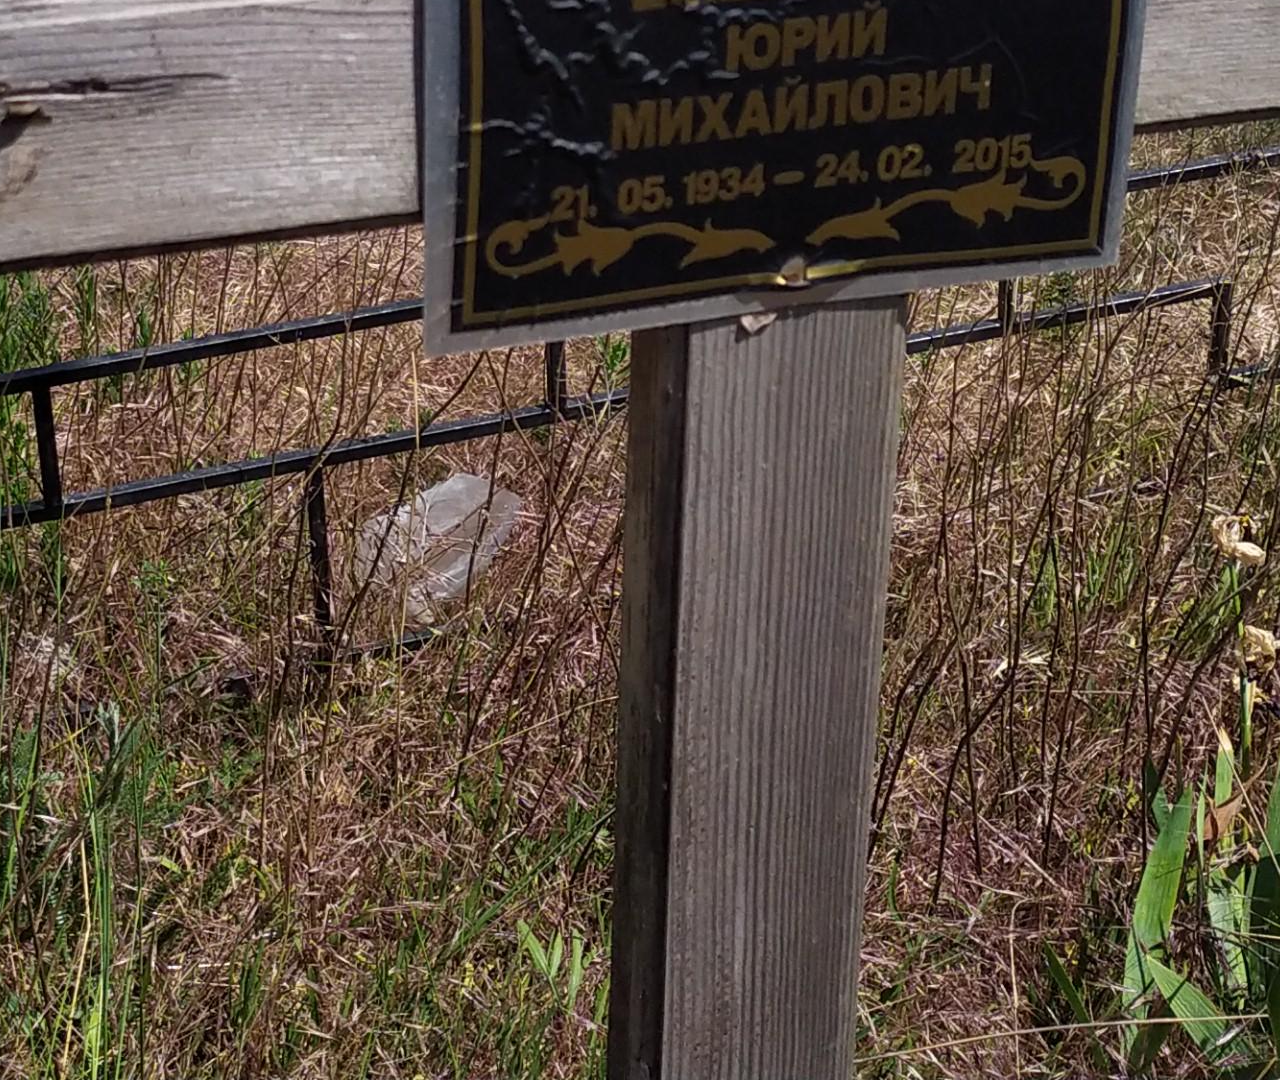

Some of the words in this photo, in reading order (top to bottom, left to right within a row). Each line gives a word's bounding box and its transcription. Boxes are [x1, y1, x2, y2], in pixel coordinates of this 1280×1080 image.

[725, 0, 888, 71] ЮРИЙ
[611, 63, 992, 151] МИХАЙЛОВИЧ
[953, 134, 1034, 172] 2015
